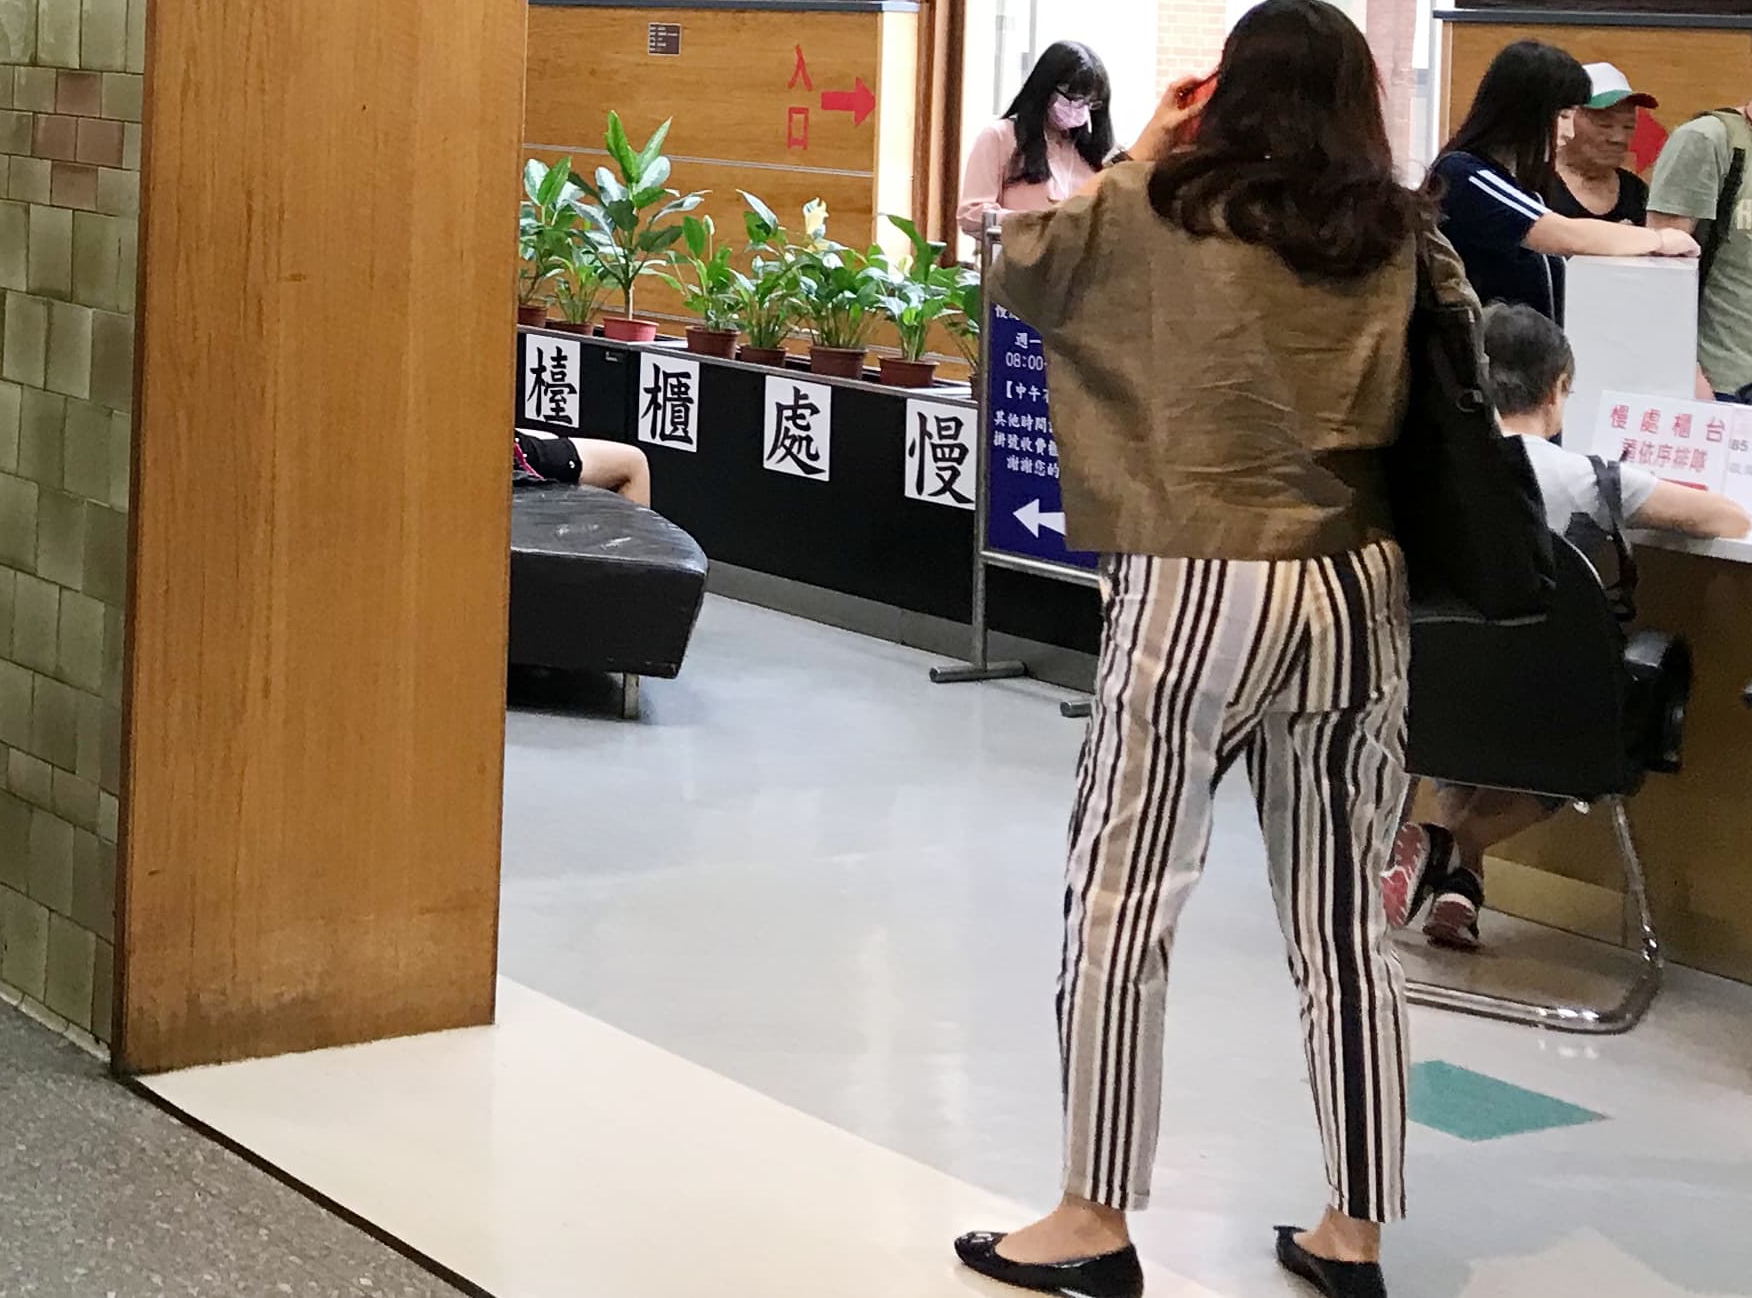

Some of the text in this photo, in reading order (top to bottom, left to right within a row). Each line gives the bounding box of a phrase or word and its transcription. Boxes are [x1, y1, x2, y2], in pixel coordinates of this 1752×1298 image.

[787, 44, 813, 150] 入口
[527, 345, 978, 506] 慢 處 櫃 檯
[994, 410, 1053, 433] 其他時間
[1610, 404, 1726, 443] 慢處櫃台
